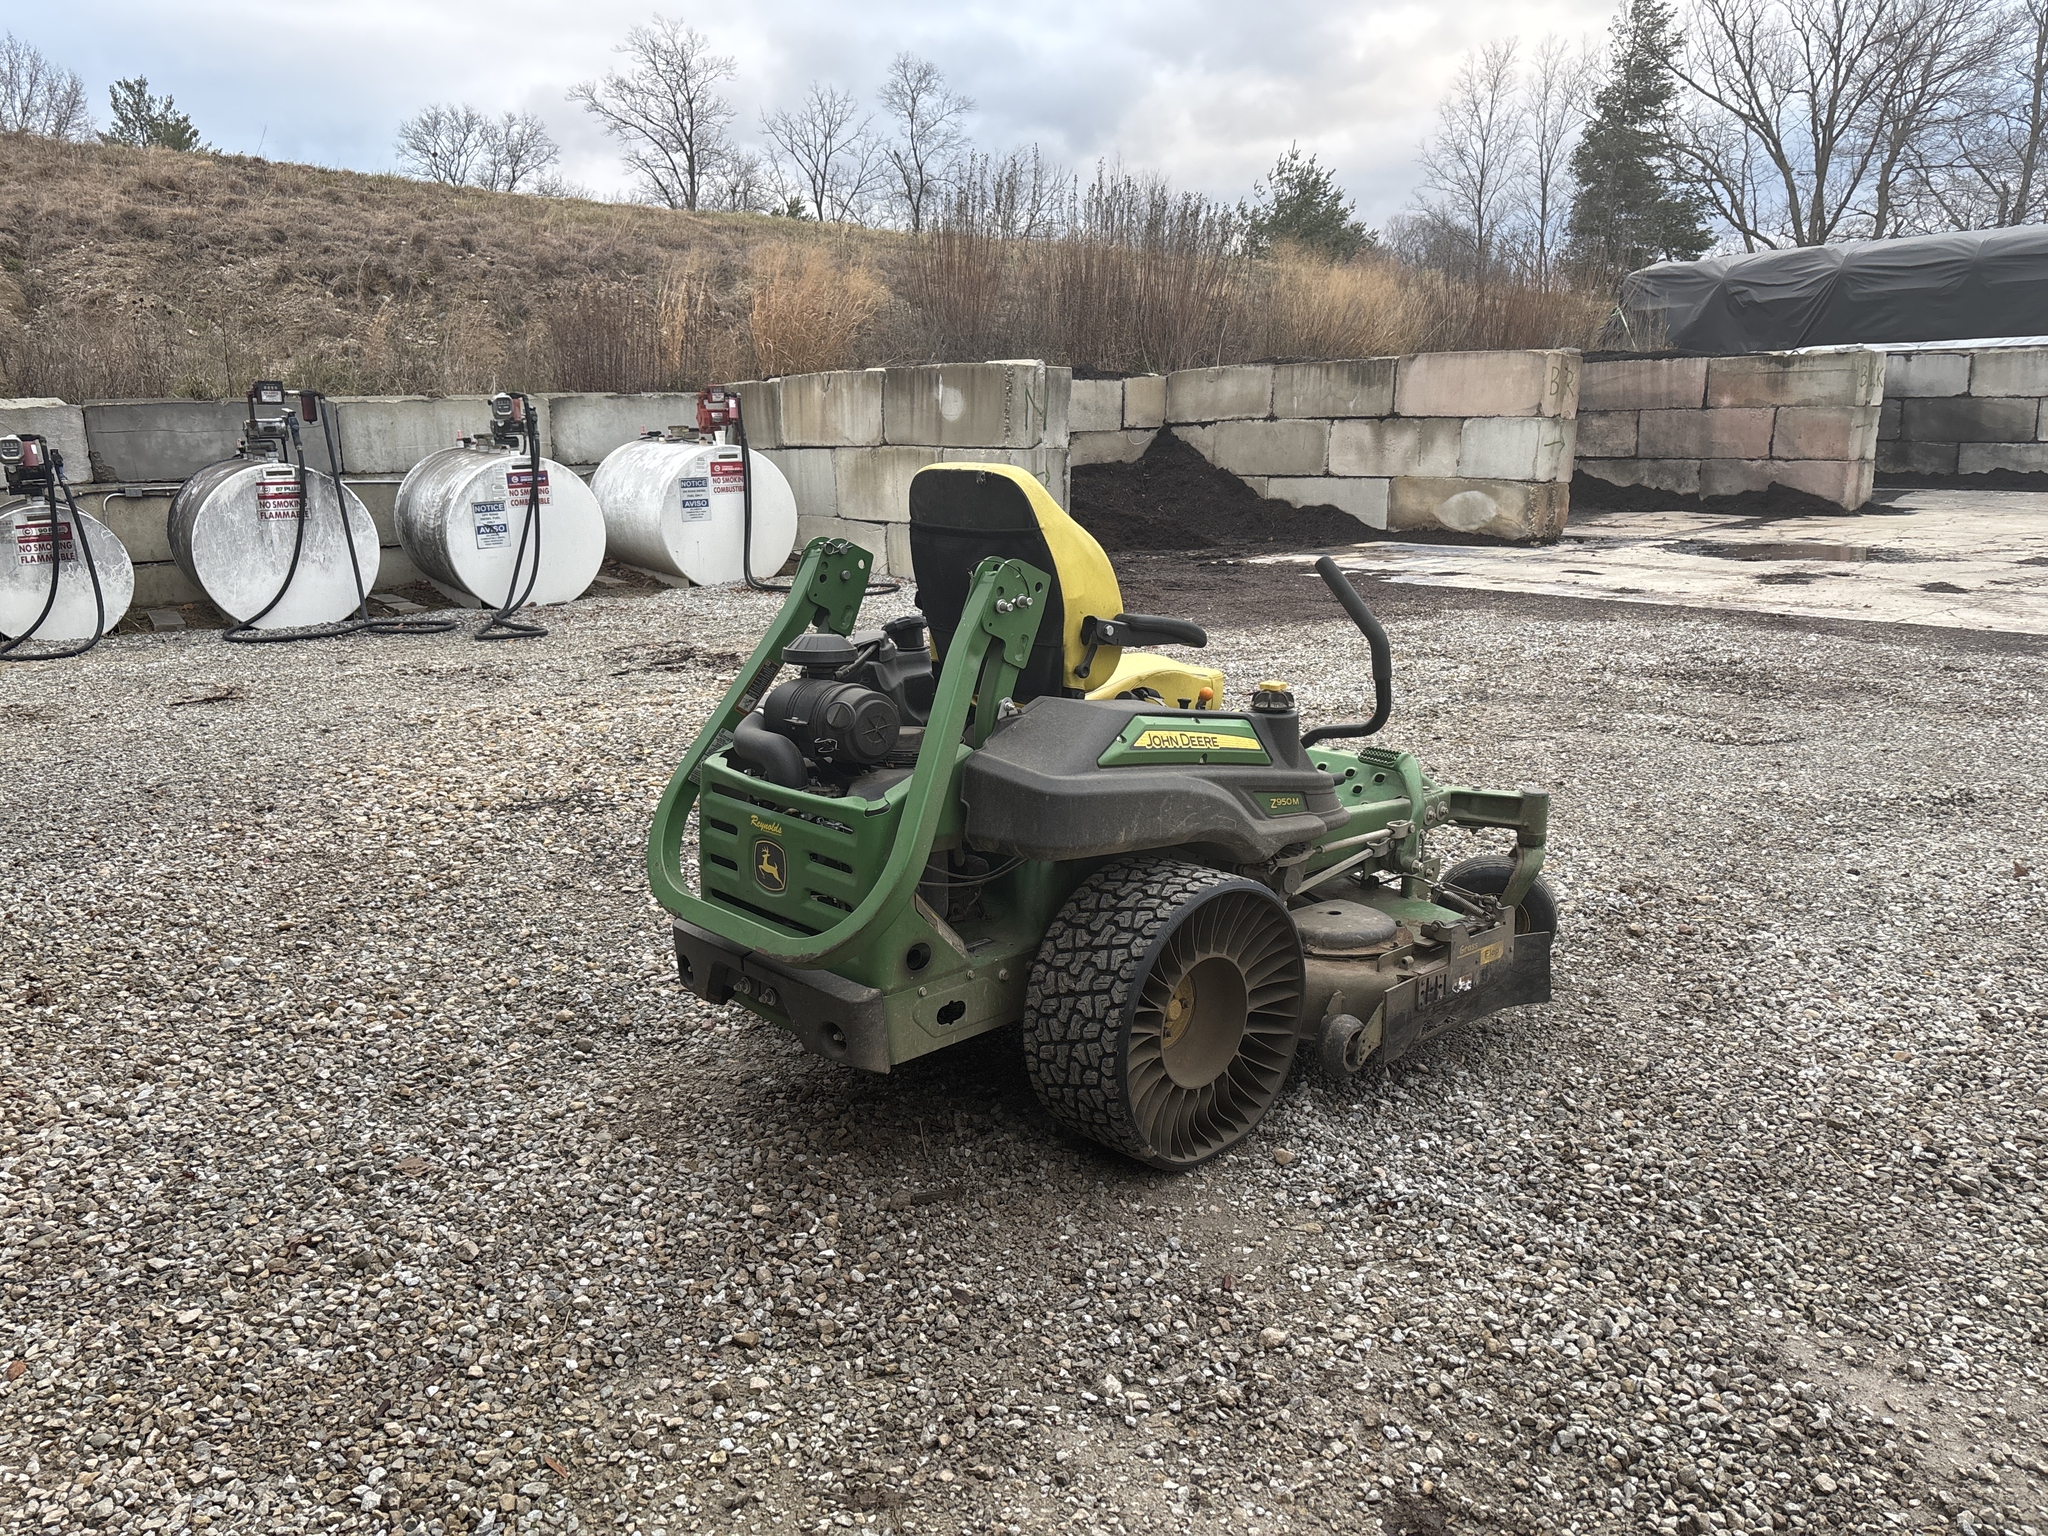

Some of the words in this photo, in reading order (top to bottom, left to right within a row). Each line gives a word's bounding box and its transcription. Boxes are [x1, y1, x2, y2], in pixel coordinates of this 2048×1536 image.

[509, 489, 519, 497] NO
[520, 488, 550, 496] SMING
[713, 486, 745, 494] COMBUSTIB
[259, 500, 271, 508] NO
[272, 500, 307, 508] SMOKIN
[474, 503, 504, 512] NOTICE
[510, 498, 550, 506] COMBIBLE
[260, 510, 309, 520] FLAMMABE
[19, 544, 32, 553] NO
[34, 541, 72, 552] SMOING
[21, 553, 75, 564] FLAMMBLE
[1146, 733, 1179, 748] JOHN
[1180, 733, 1220, 748] DEERE
[1270, 797, 1300, 809] Z950M
[750, 814, 783, 834] Reynolds
[1459, 942, 1479, 955] Grass
[1484, 948, 1500, 960] Flap
